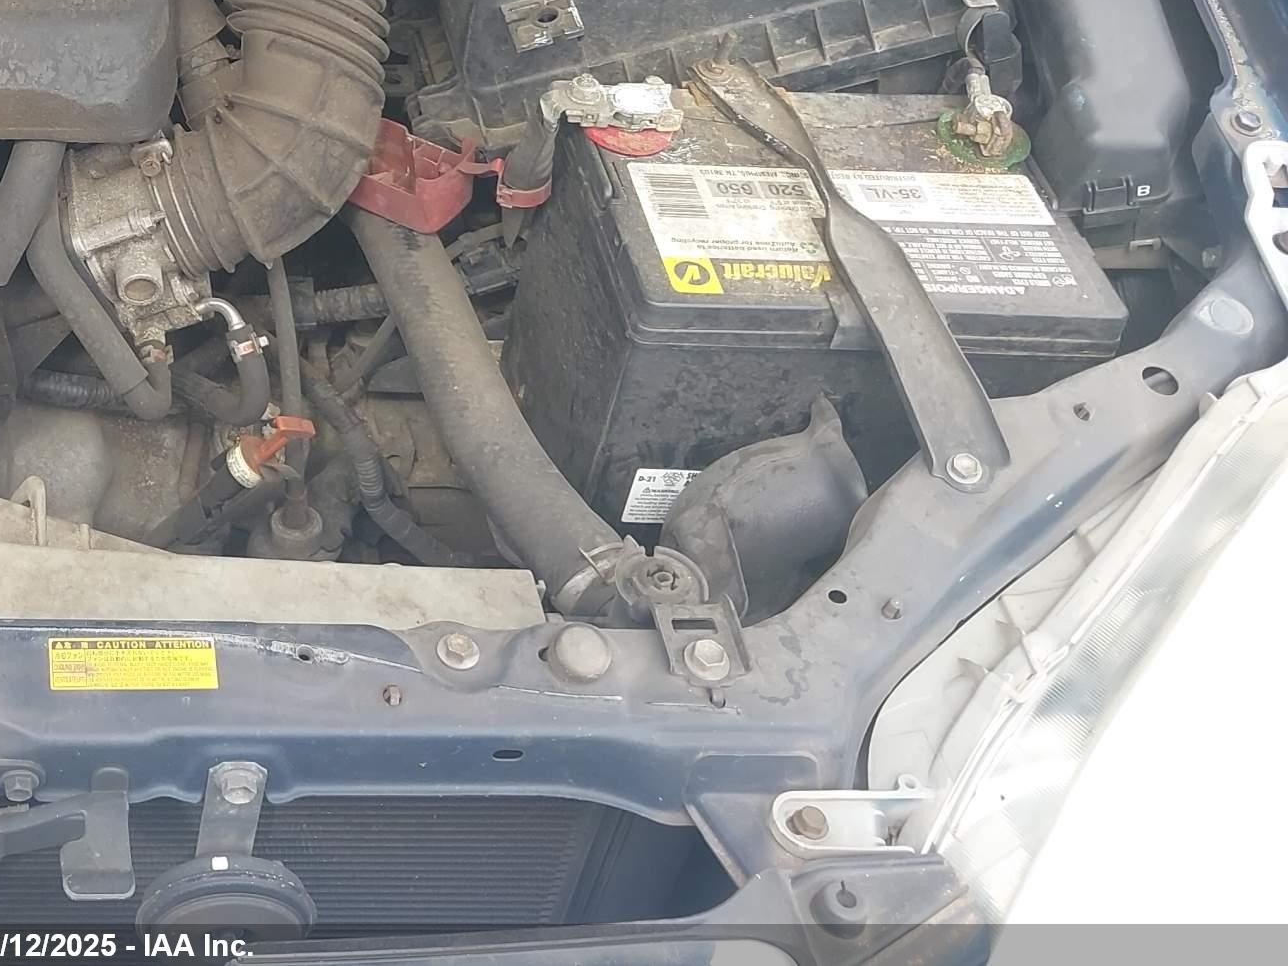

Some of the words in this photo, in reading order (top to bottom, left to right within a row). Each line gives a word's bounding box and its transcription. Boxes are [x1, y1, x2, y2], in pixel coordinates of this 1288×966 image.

[716, 183, 753, 196] 650
[768, 184, 805, 196] 520
[865, 188, 922, 200] 35-VL
[722, 264, 831, 289] Valucraft
[96, 640, 146, 649] CAUTION
[154, 640, 210, 650] ATTENTION
